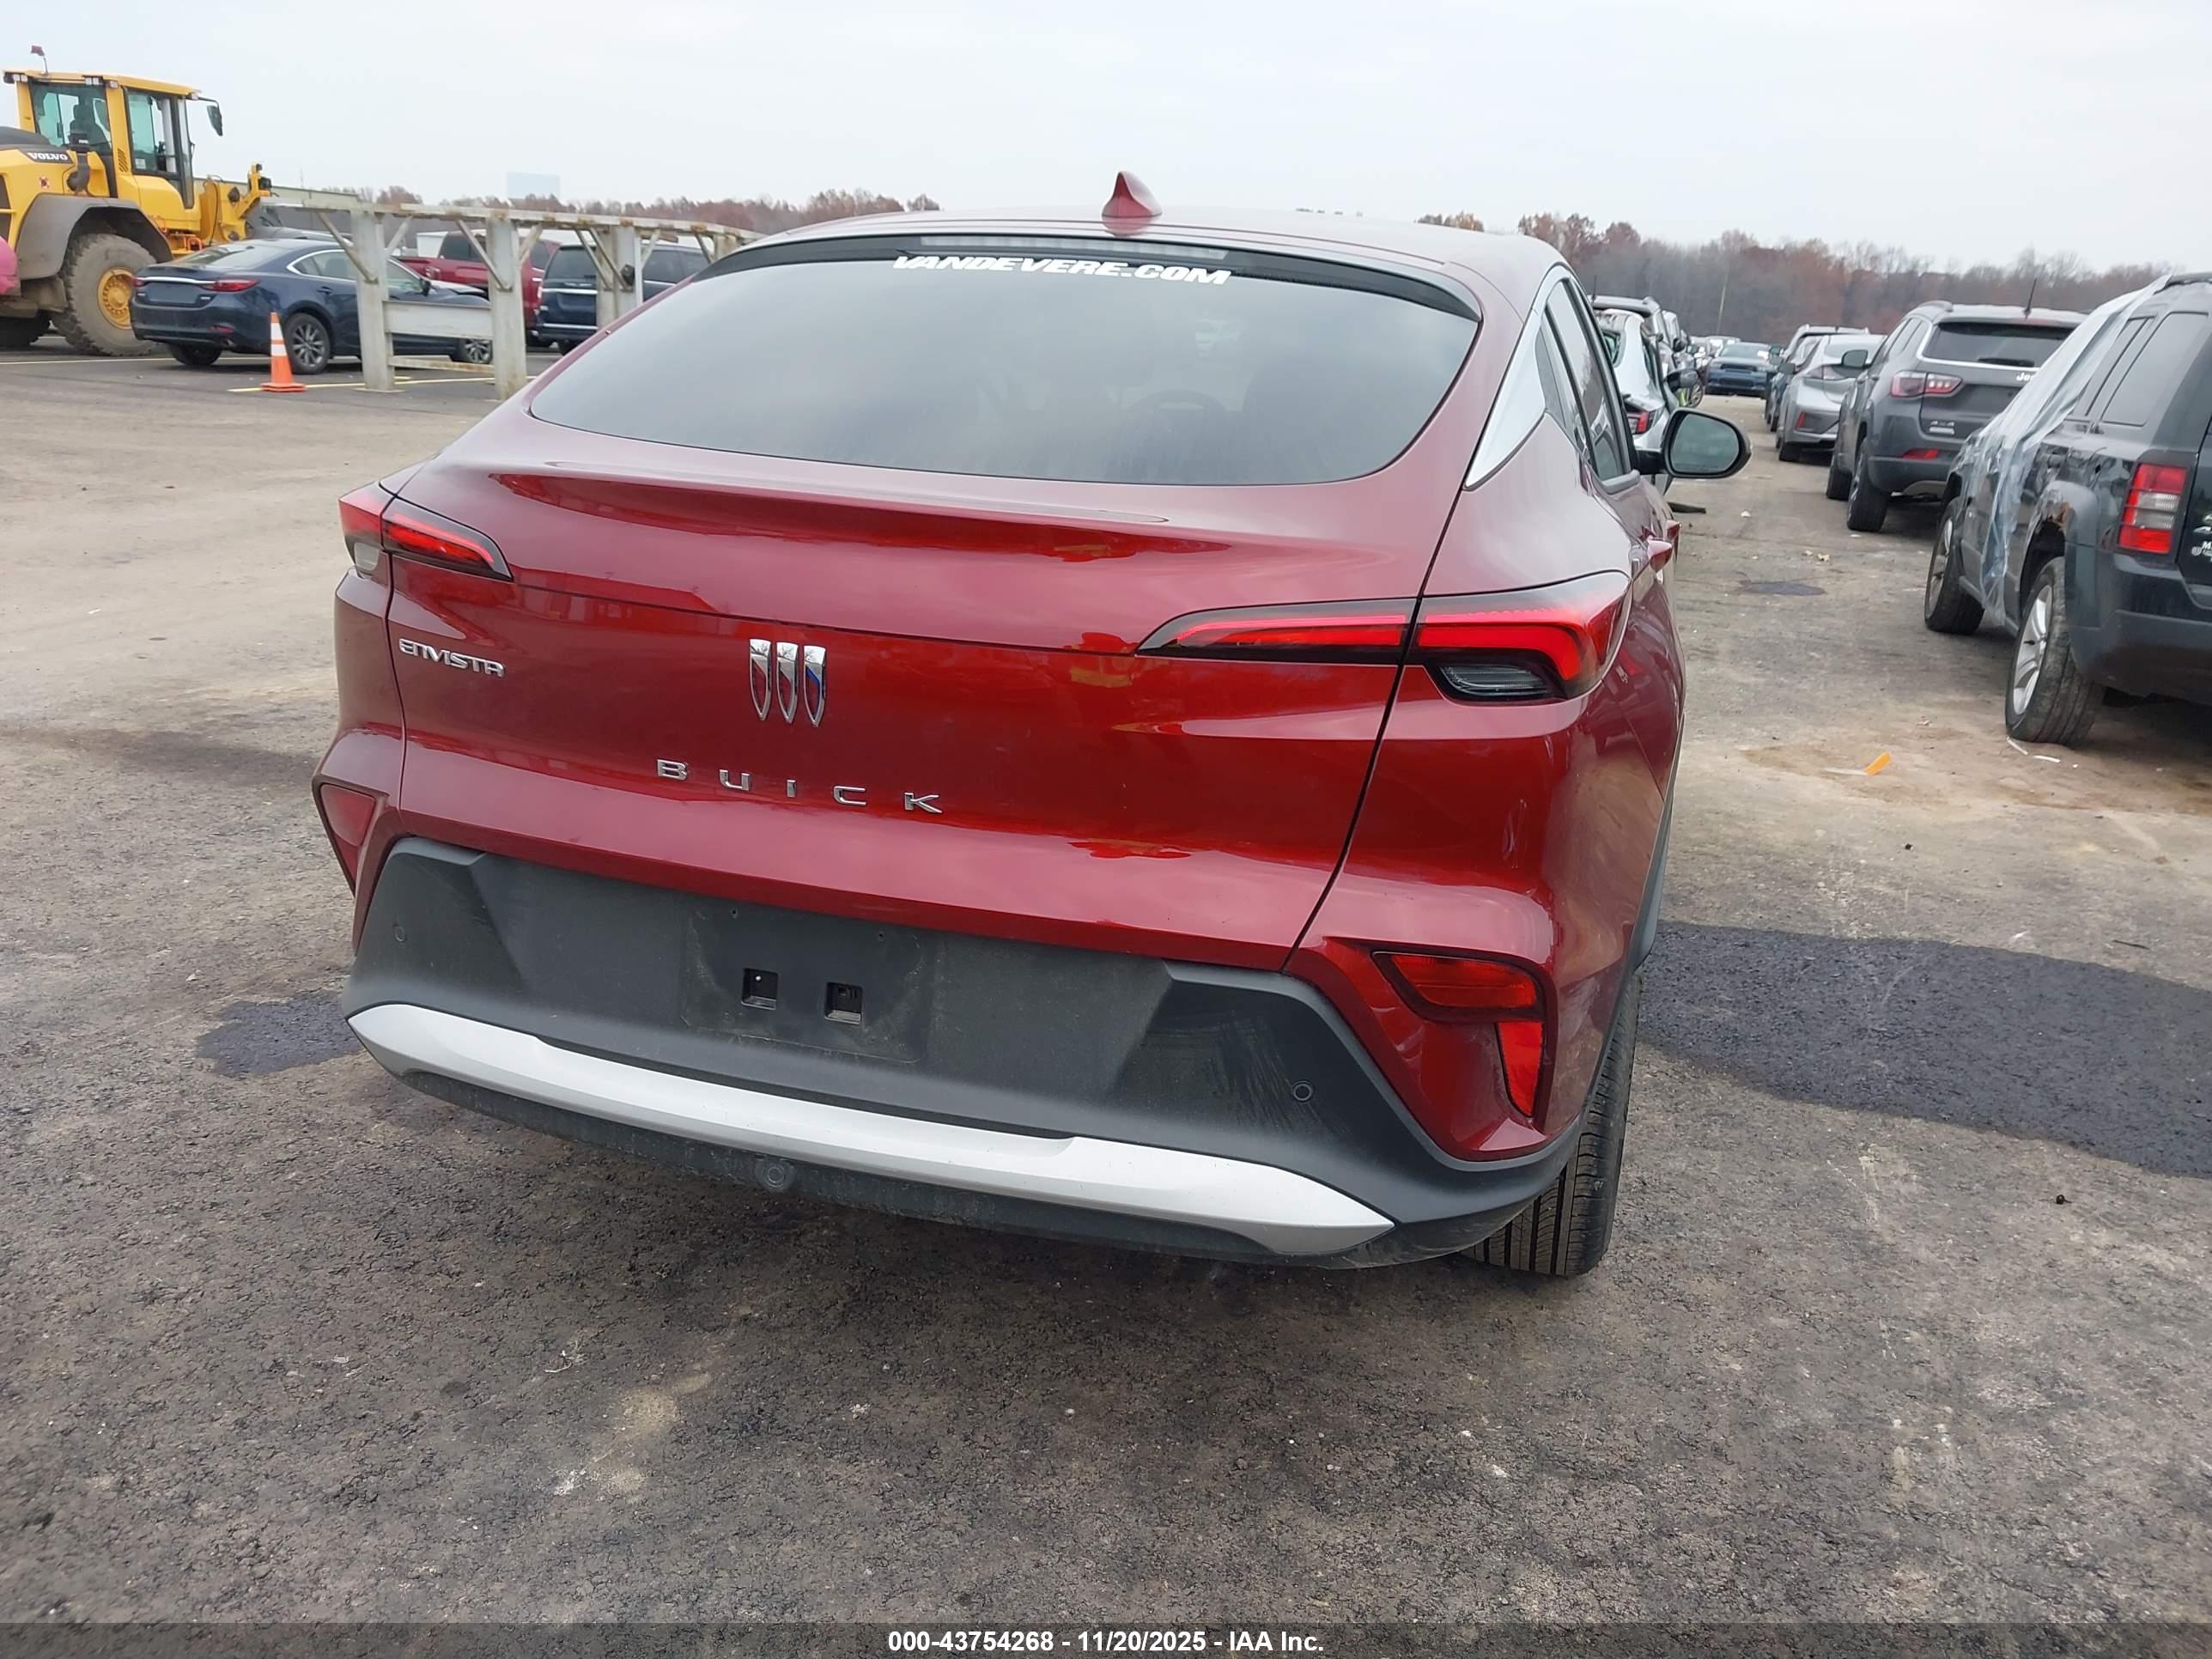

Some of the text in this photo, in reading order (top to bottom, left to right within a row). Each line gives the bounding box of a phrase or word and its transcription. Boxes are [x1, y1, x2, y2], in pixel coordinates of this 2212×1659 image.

[27, 152, 69, 161] VOLVO
[892, 255, 1232, 285] VANDEVERE.COM
[398, 638, 506, 678] ENVISTA
[656, 759, 944, 814] BUICK
